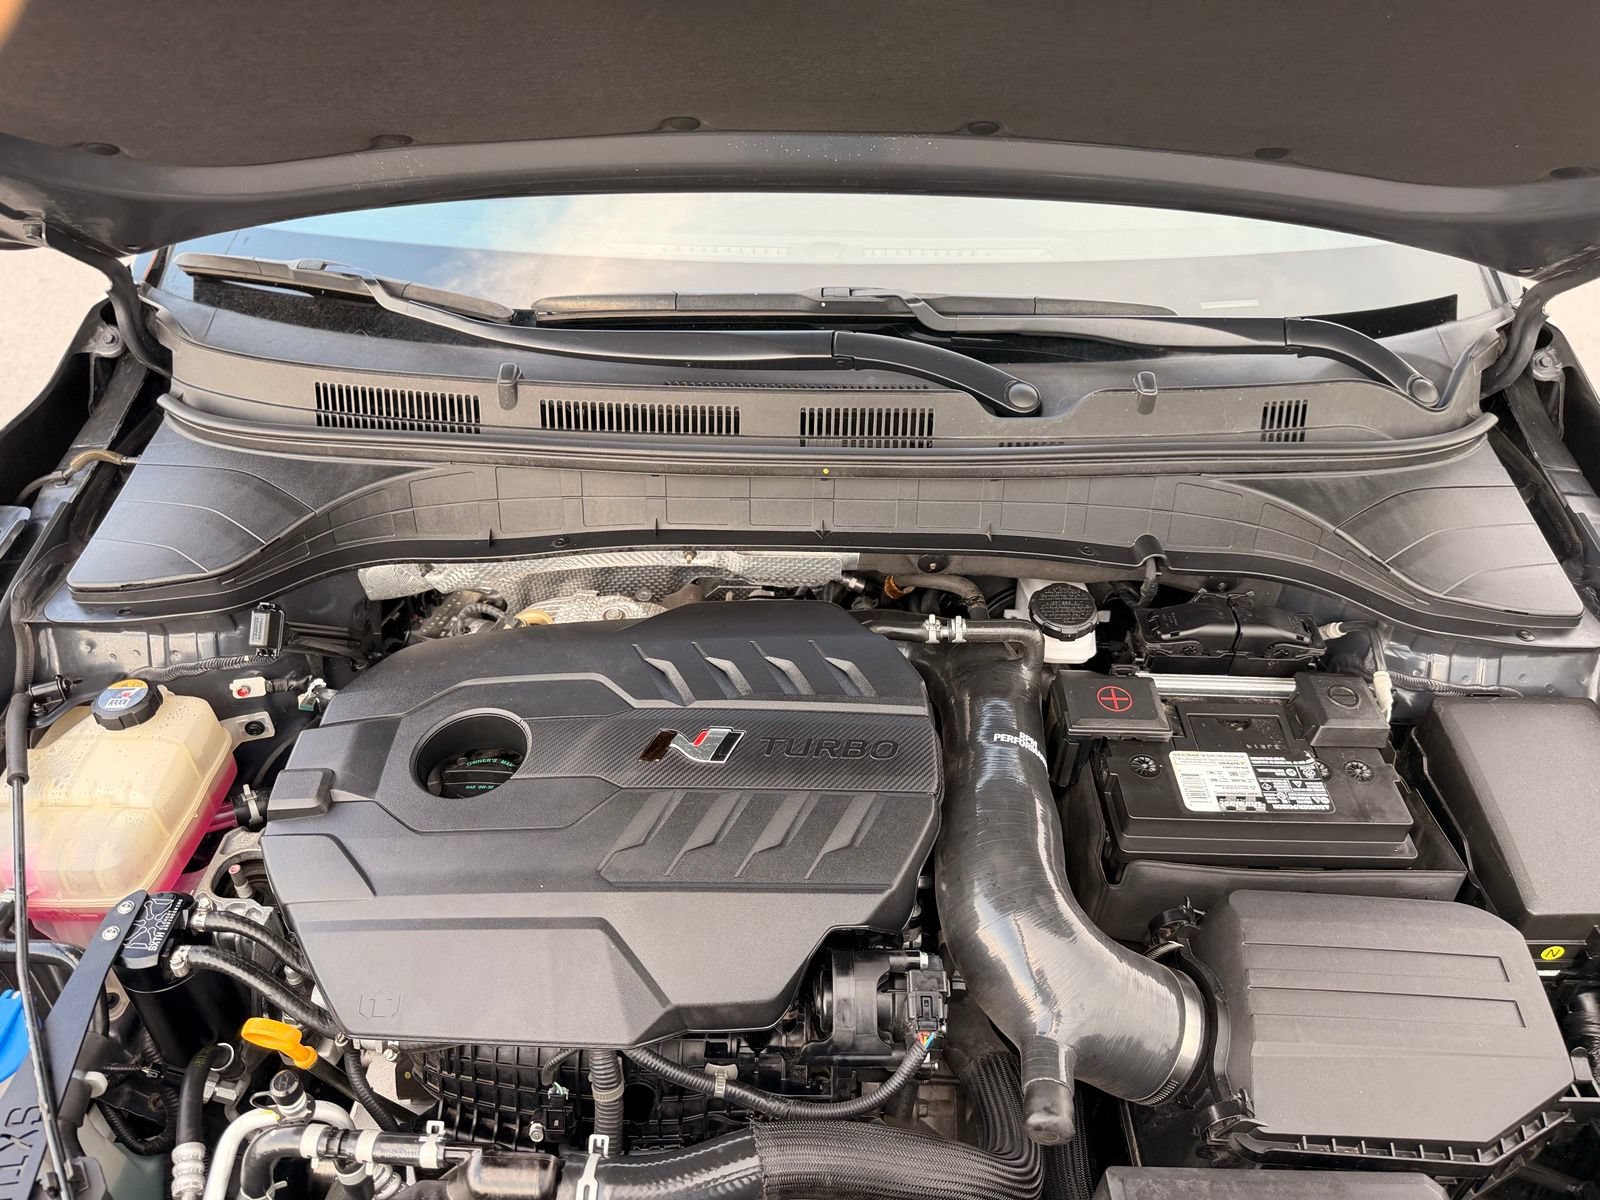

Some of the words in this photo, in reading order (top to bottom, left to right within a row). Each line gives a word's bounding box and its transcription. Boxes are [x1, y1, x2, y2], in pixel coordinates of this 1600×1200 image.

[758, 737, 901, 760] TURBO
[1019, 731, 1038, 749] RPM
[467, 758, 498, 767] OWNER'S
[147, 932, 165, 951] SXTH
